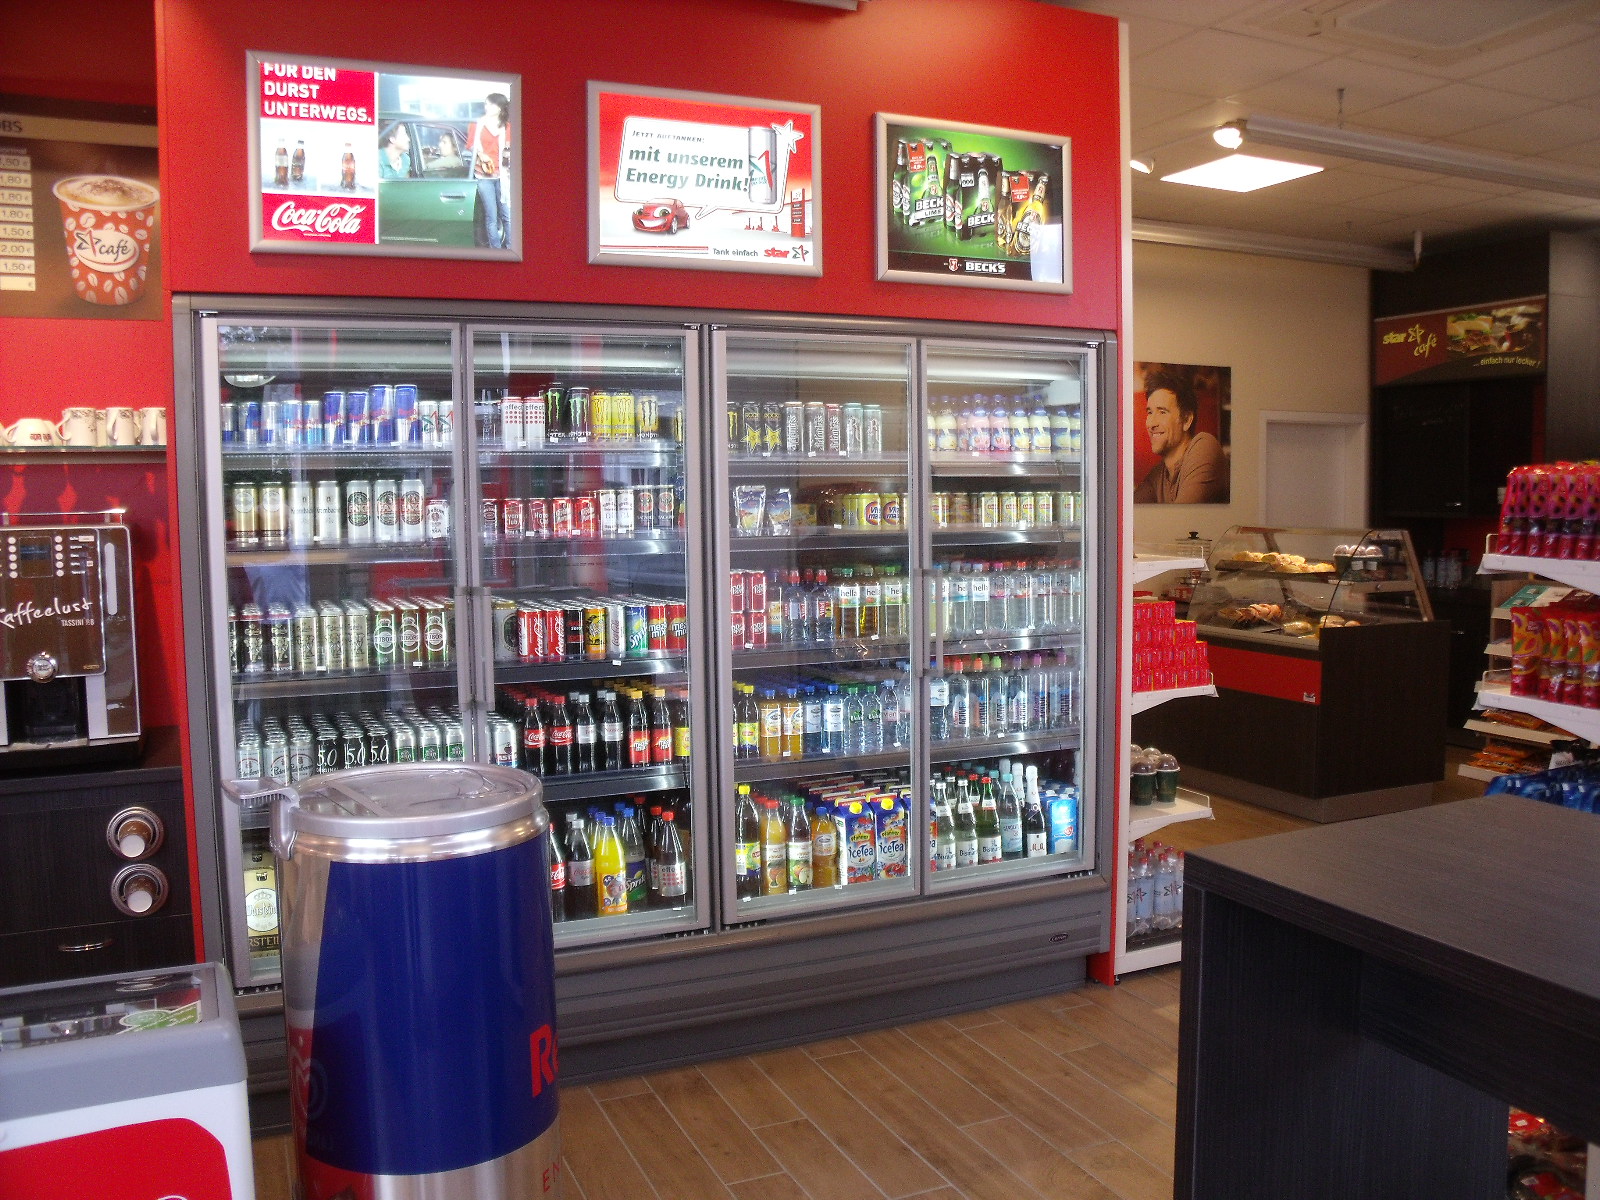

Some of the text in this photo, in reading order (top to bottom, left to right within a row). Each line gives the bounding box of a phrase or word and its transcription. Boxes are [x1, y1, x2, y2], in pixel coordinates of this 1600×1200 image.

[301, 66, 337, 82] DEN
[264, 81, 320, 99] DURST
[264, 101, 373, 123] UNTERWEGS.
[628, 146, 744, 170] mit unserem
[626, 167, 689, 190] Energy
[695, 172, 750, 193] Drink!
[271, 201, 366, 235] Coca-Cola
[99, 241, 131, 262] café
[713, 247, 759, 257] Tank einfach
[763, 247, 790, 259] star
[61, 619, 84, 627] TASSINI
[848, 844, 874, 859] iceTea
[878, 839, 904, 855] iceTea
